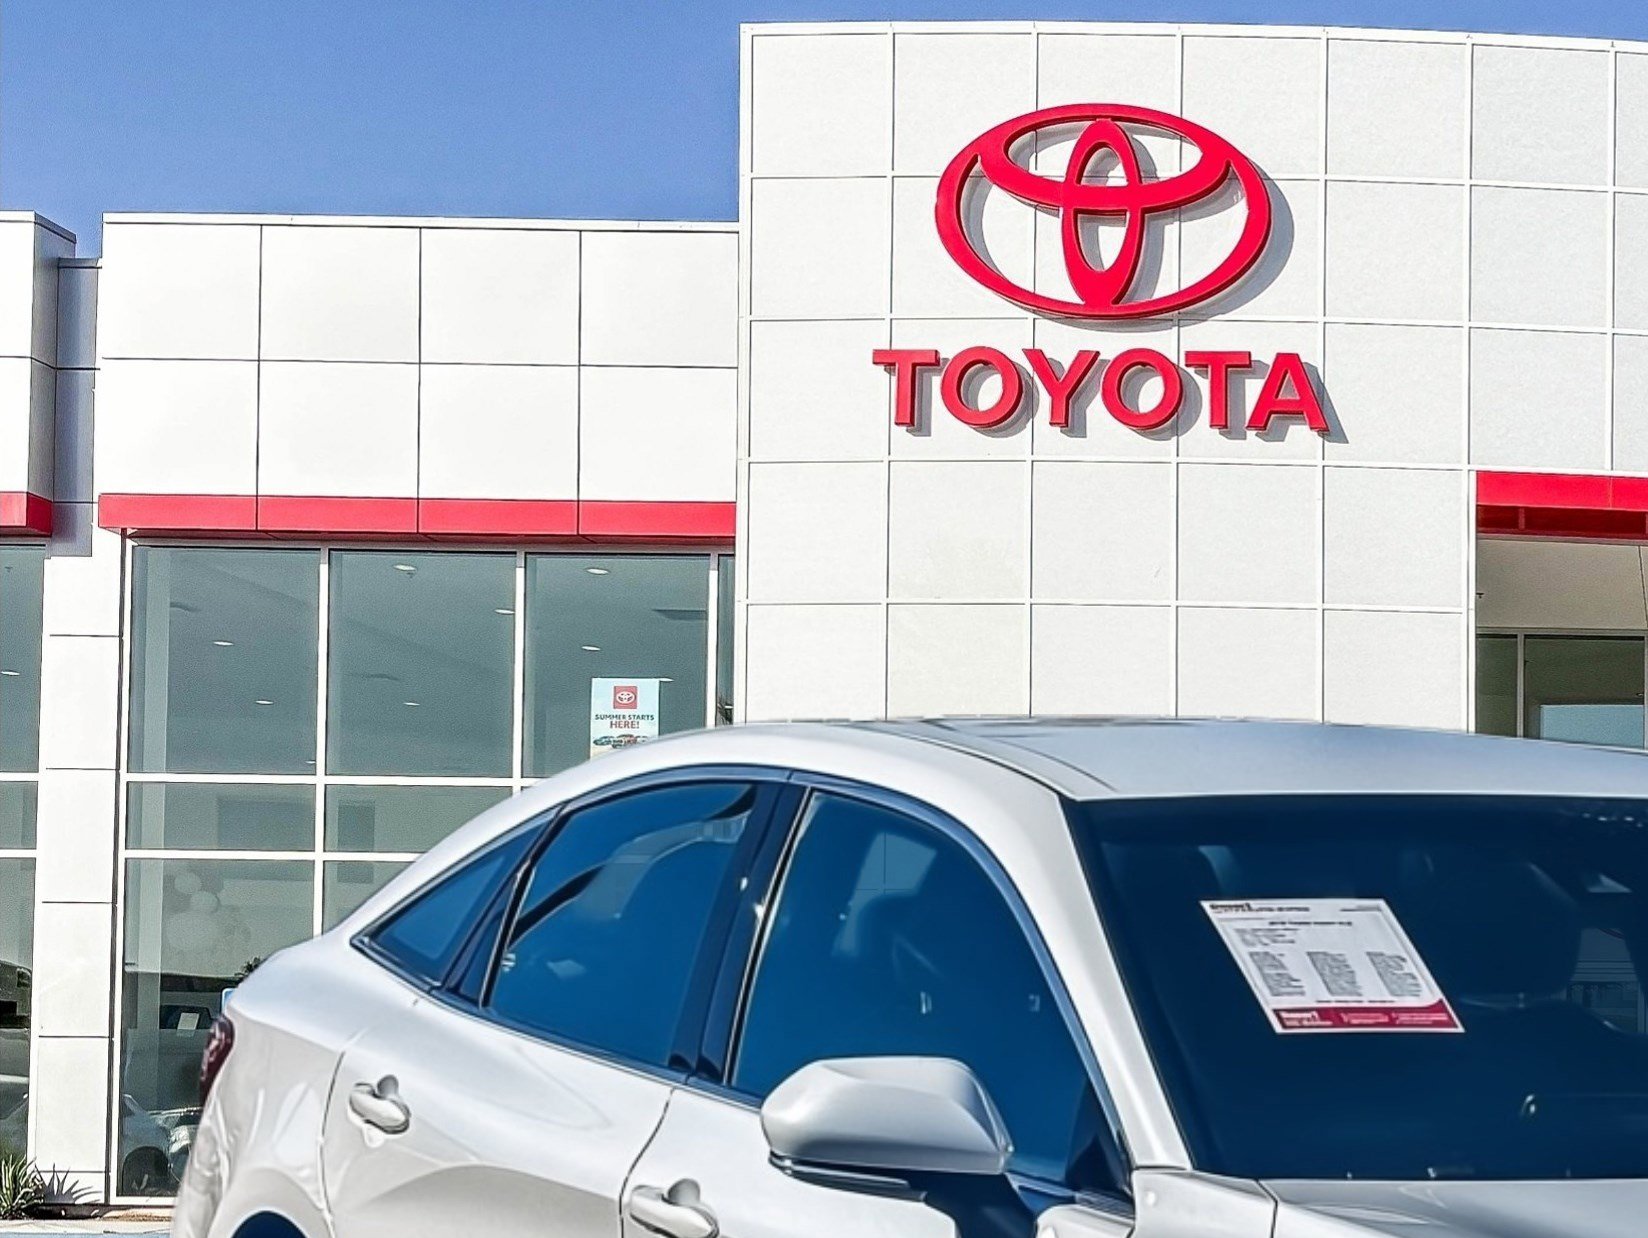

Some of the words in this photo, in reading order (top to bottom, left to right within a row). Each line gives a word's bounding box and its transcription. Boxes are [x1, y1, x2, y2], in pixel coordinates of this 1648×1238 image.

[872, 345, 1330, 433] TOYOTA
[594, 713, 627, 721] SUMMER
[628, 713, 655, 721] STARTS
[609, 720, 640, 729] HERE!
